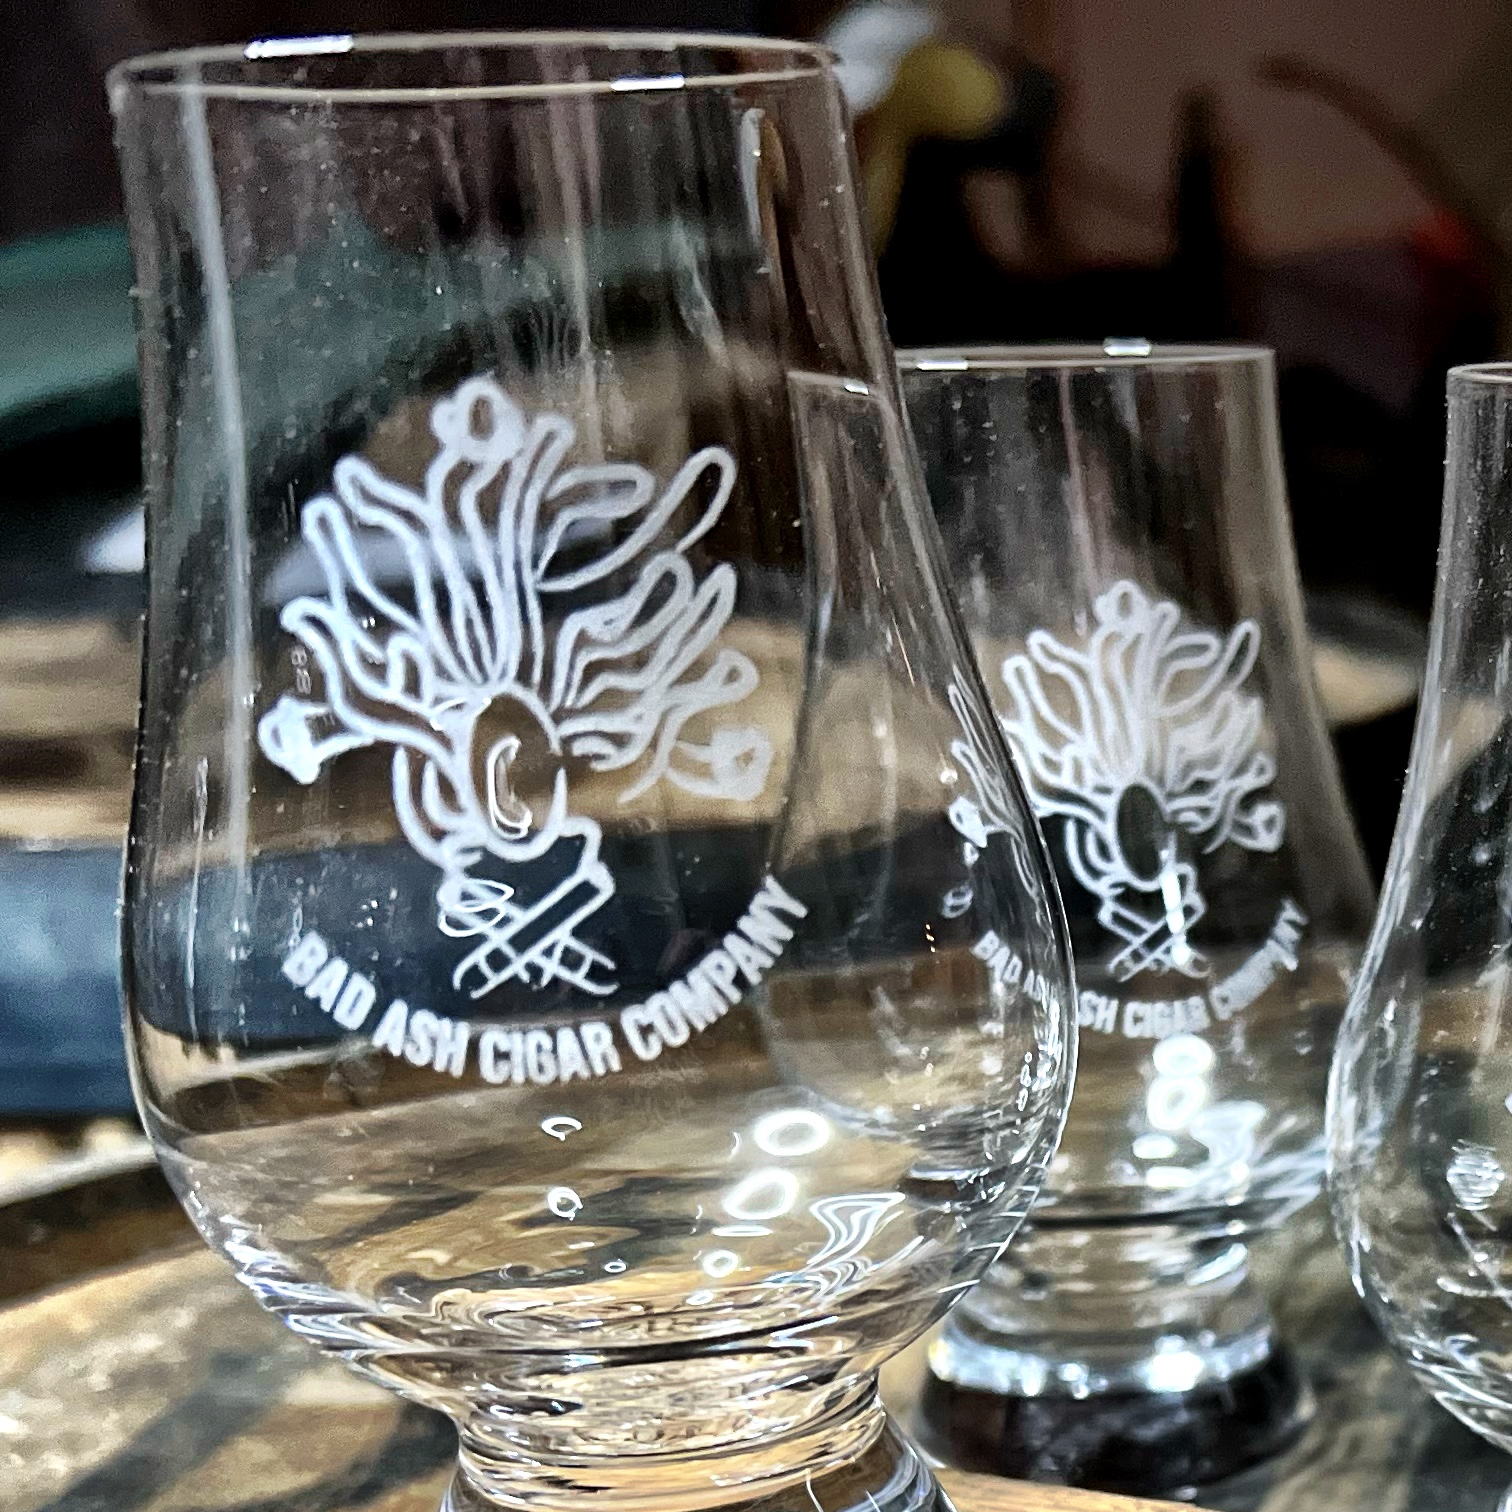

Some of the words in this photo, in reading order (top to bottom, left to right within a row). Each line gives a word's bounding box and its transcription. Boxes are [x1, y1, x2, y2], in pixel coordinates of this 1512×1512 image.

[283, 932, 376, 1030] BAD
[371, 999, 470, 1078] ASH
[477, 1022, 622, 1085] CIGAR
[620, 875, 808, 1061] COMPANY
